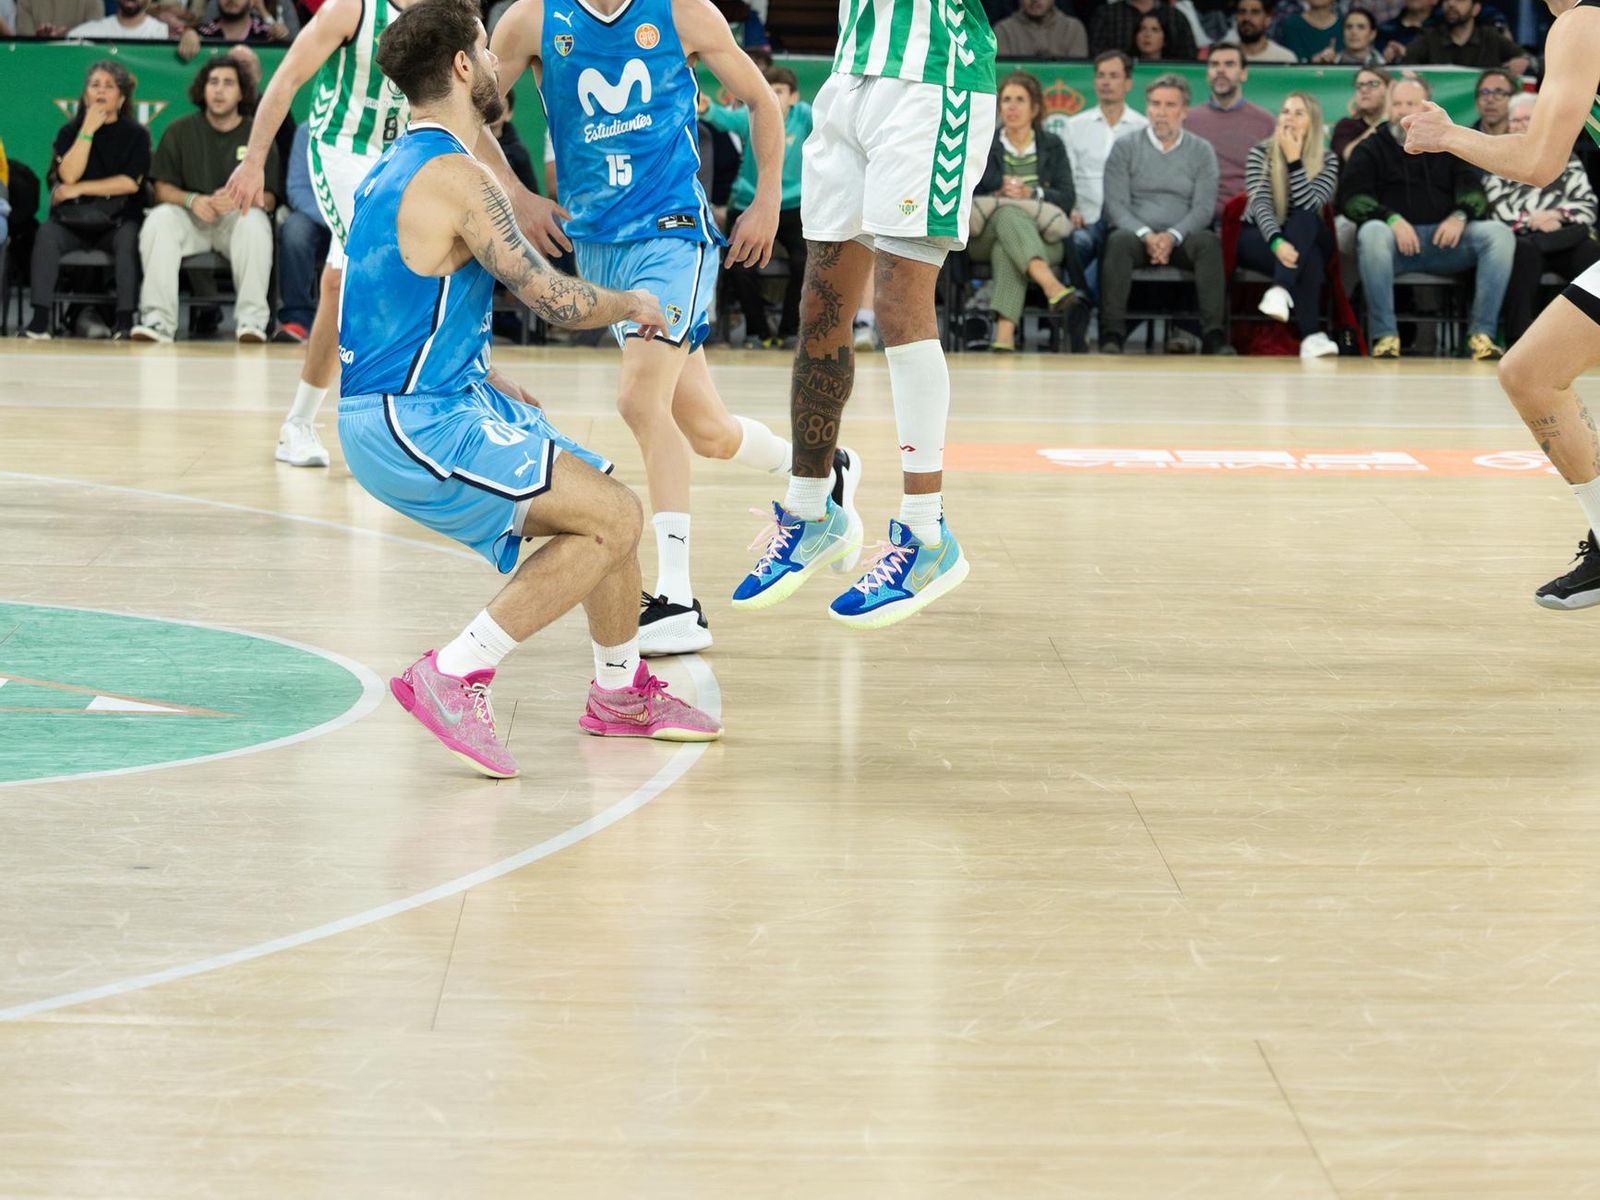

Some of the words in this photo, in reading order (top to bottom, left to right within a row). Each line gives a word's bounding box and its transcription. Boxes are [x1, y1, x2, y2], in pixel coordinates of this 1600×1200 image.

[383, 116, 398, 142] 8
[583, 113, 653, 144] Estudiantes
[605, 154, 633, 187] 15
